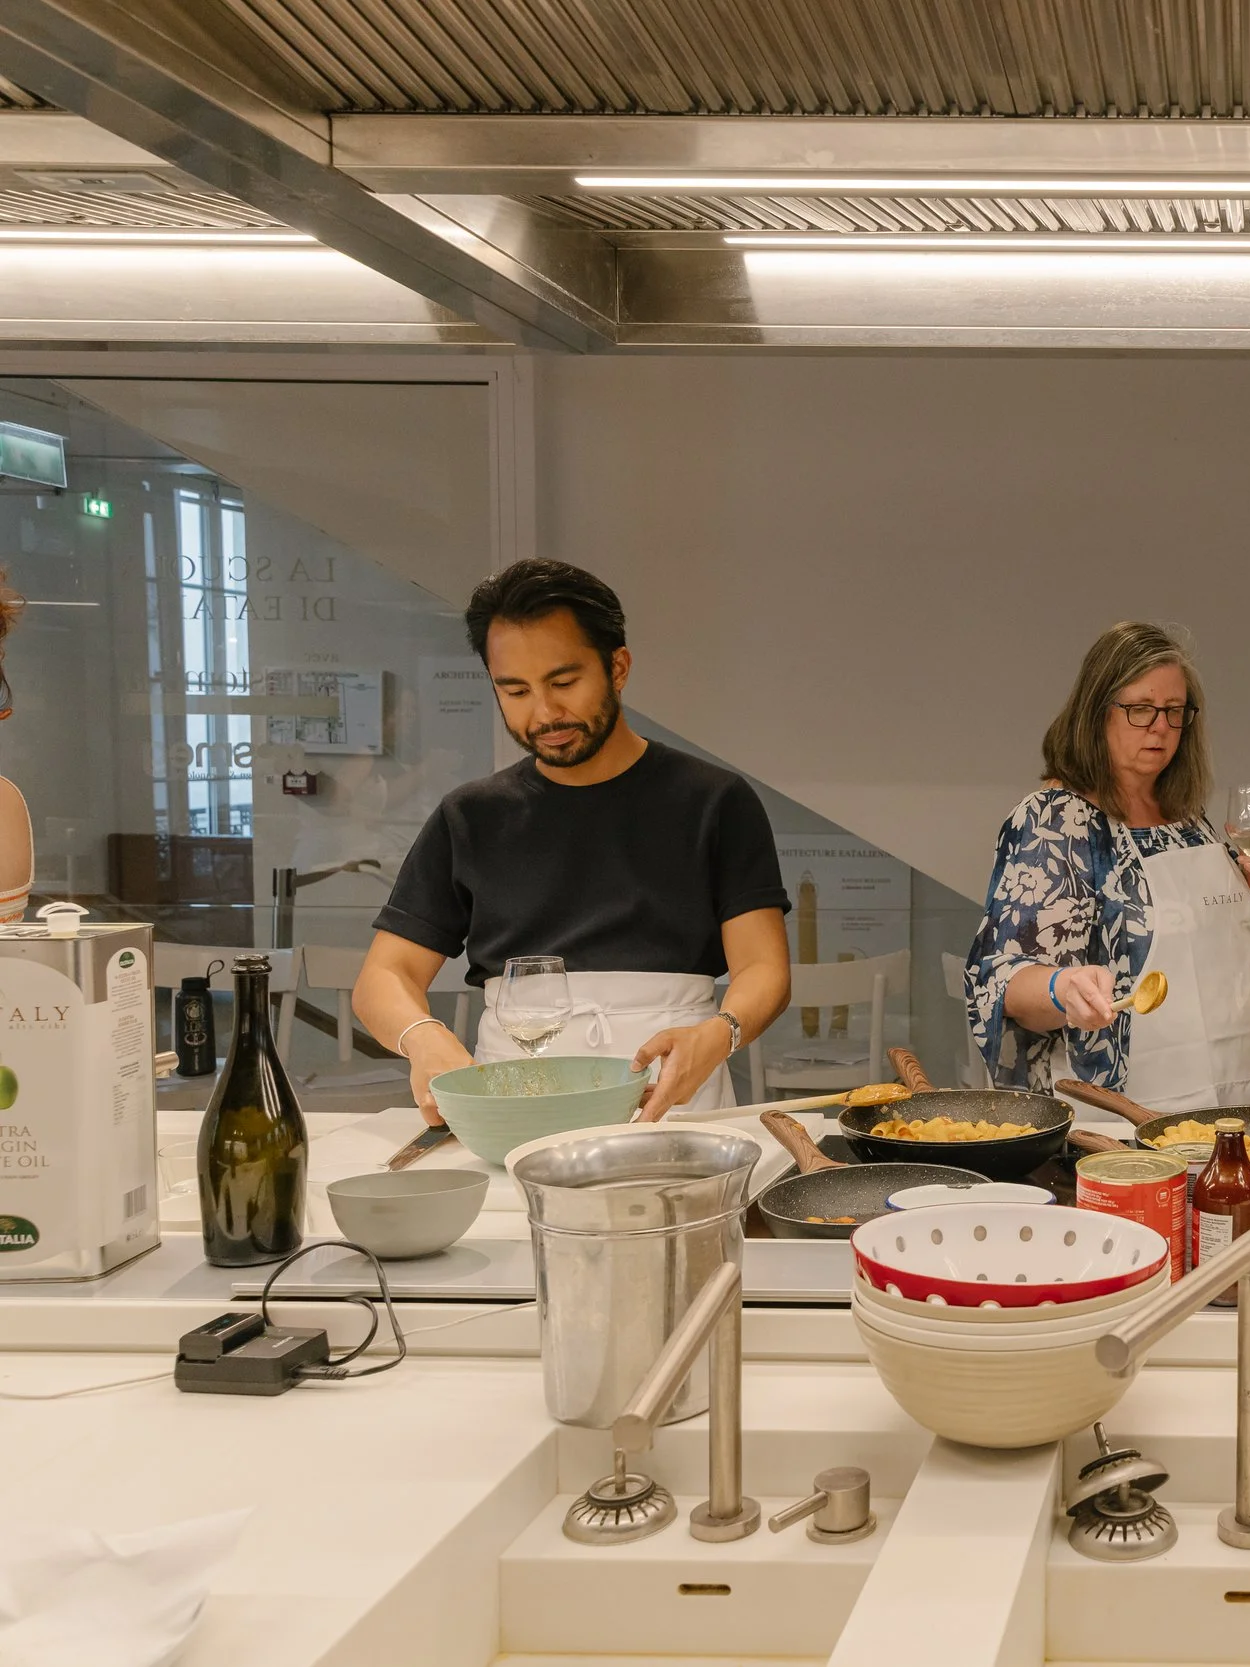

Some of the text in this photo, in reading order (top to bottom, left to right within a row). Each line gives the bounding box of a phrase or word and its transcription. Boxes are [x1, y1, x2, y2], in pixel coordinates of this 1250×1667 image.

[1203, 892, 1243, 905] EATALY
[0, 1006, 70, 1021] ALY
[18, 1156, 50, 1168] OIL
